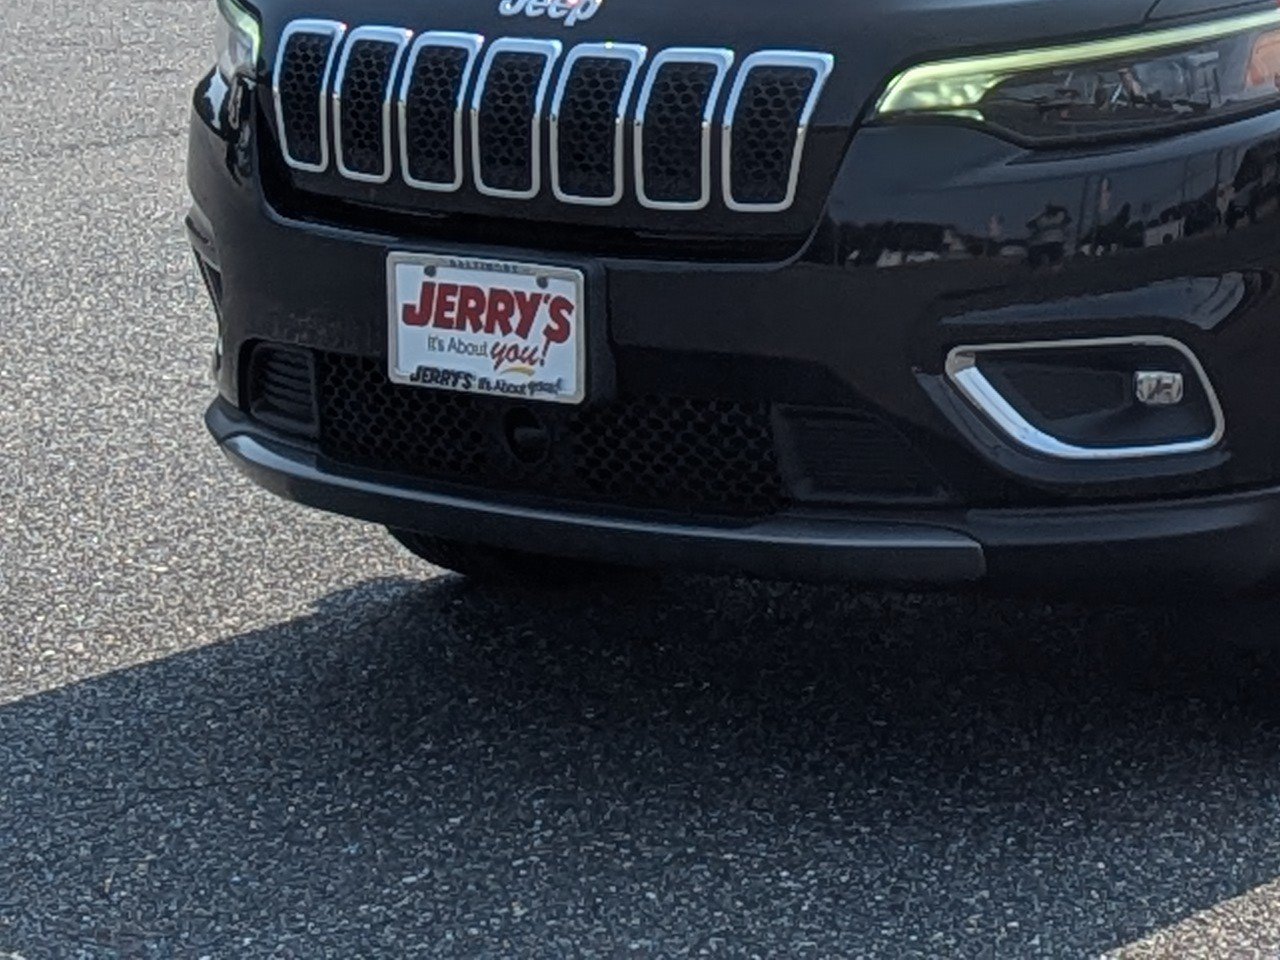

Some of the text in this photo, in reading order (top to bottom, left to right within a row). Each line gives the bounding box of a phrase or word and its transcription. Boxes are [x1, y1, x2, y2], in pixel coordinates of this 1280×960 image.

[402, 281, 575, 344] JERRY'S
[447, 336, 488, 357] About
[489, 339, 550, 371] you!
[409, 365, 474, 390] JERRY'S
